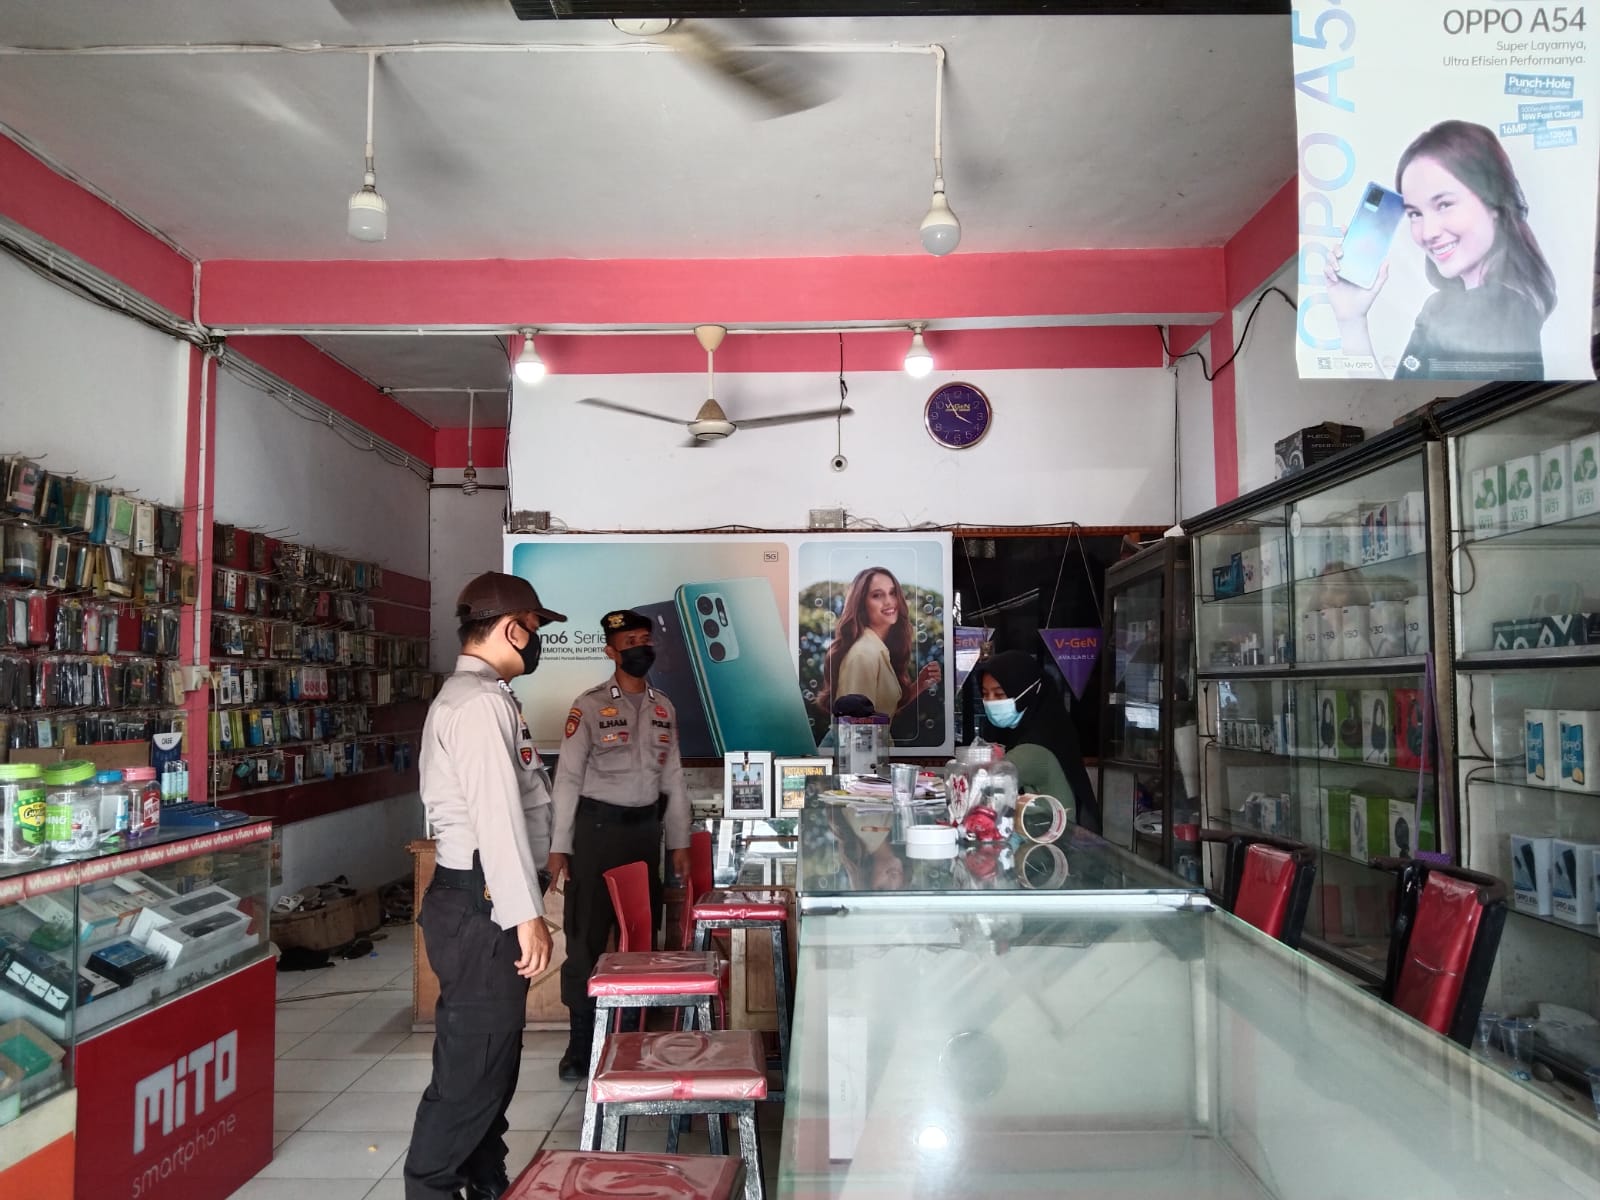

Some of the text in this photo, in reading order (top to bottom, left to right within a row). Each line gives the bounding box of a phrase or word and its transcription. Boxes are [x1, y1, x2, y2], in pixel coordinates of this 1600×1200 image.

[1443, 6, 1586, 35] OPPO A54
[1496, 39, 1586, 54] Super Layarnya,
[1292, 0, 1356, 113] A5
[1443, 54, 1586, 67] Ultra Efisien Performanya.
[1509, 76, 1572, 89] Punch-Hole
[1502, 123, 1527, 135] 16MP
[540, 631, 606, 644] no6 Serie
[600, 719, 628, 729] ILHAM
[131, 1113, 236, 1199] smartphone
